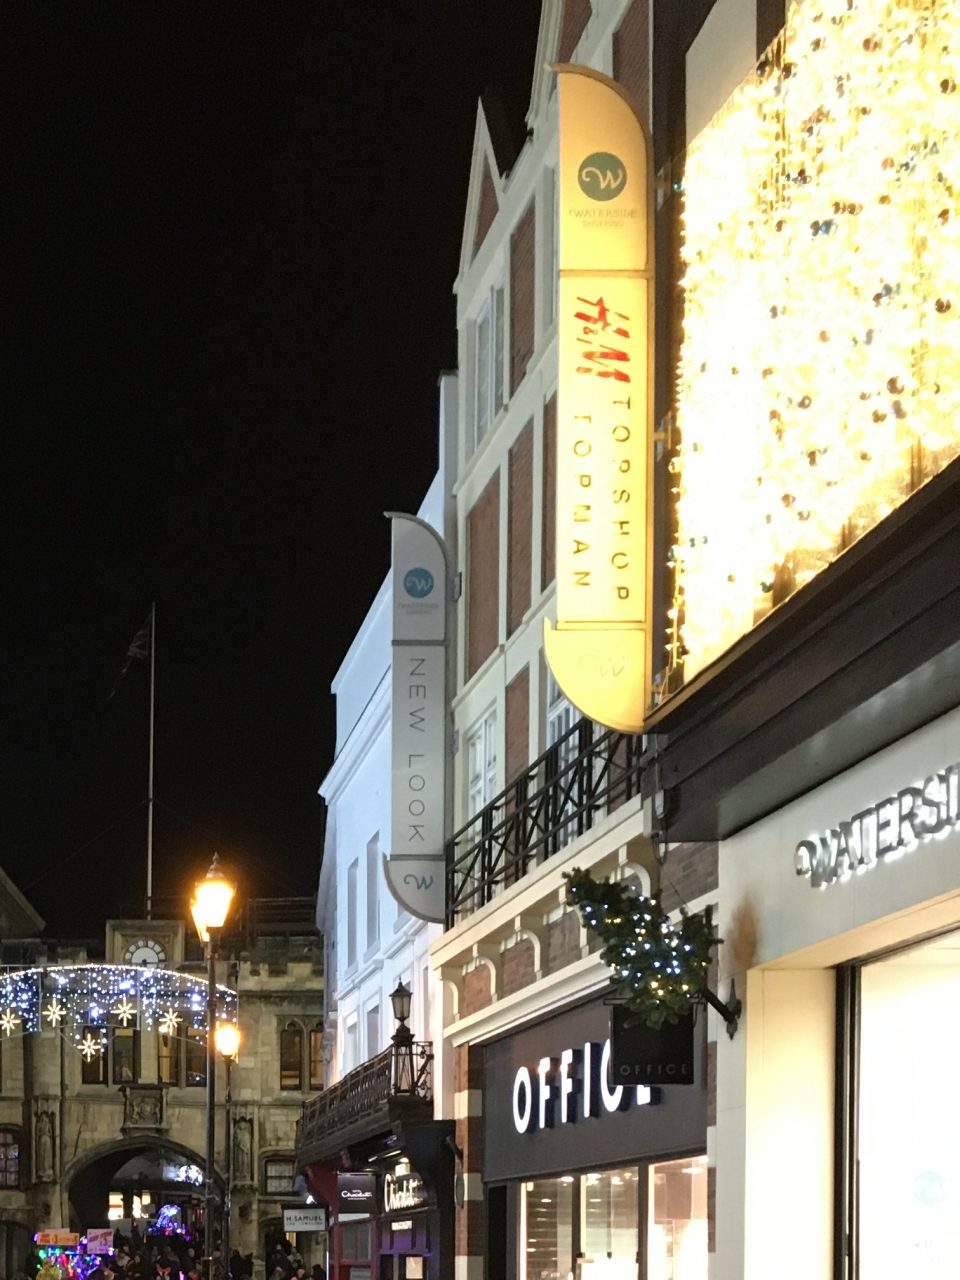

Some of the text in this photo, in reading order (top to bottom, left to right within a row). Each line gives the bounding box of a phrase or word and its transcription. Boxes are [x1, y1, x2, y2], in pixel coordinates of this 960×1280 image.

[574, 297, 630, 383] H&M
[573, 415, 592, 588] TOPMAN
[611, 395, 631, 600] TOPSHOP
[408, 658, 426, 842] NEW LOOK
[795, 764, 960, 888] WATERSI
[619, 1064, 688, 1077] OFFICE
